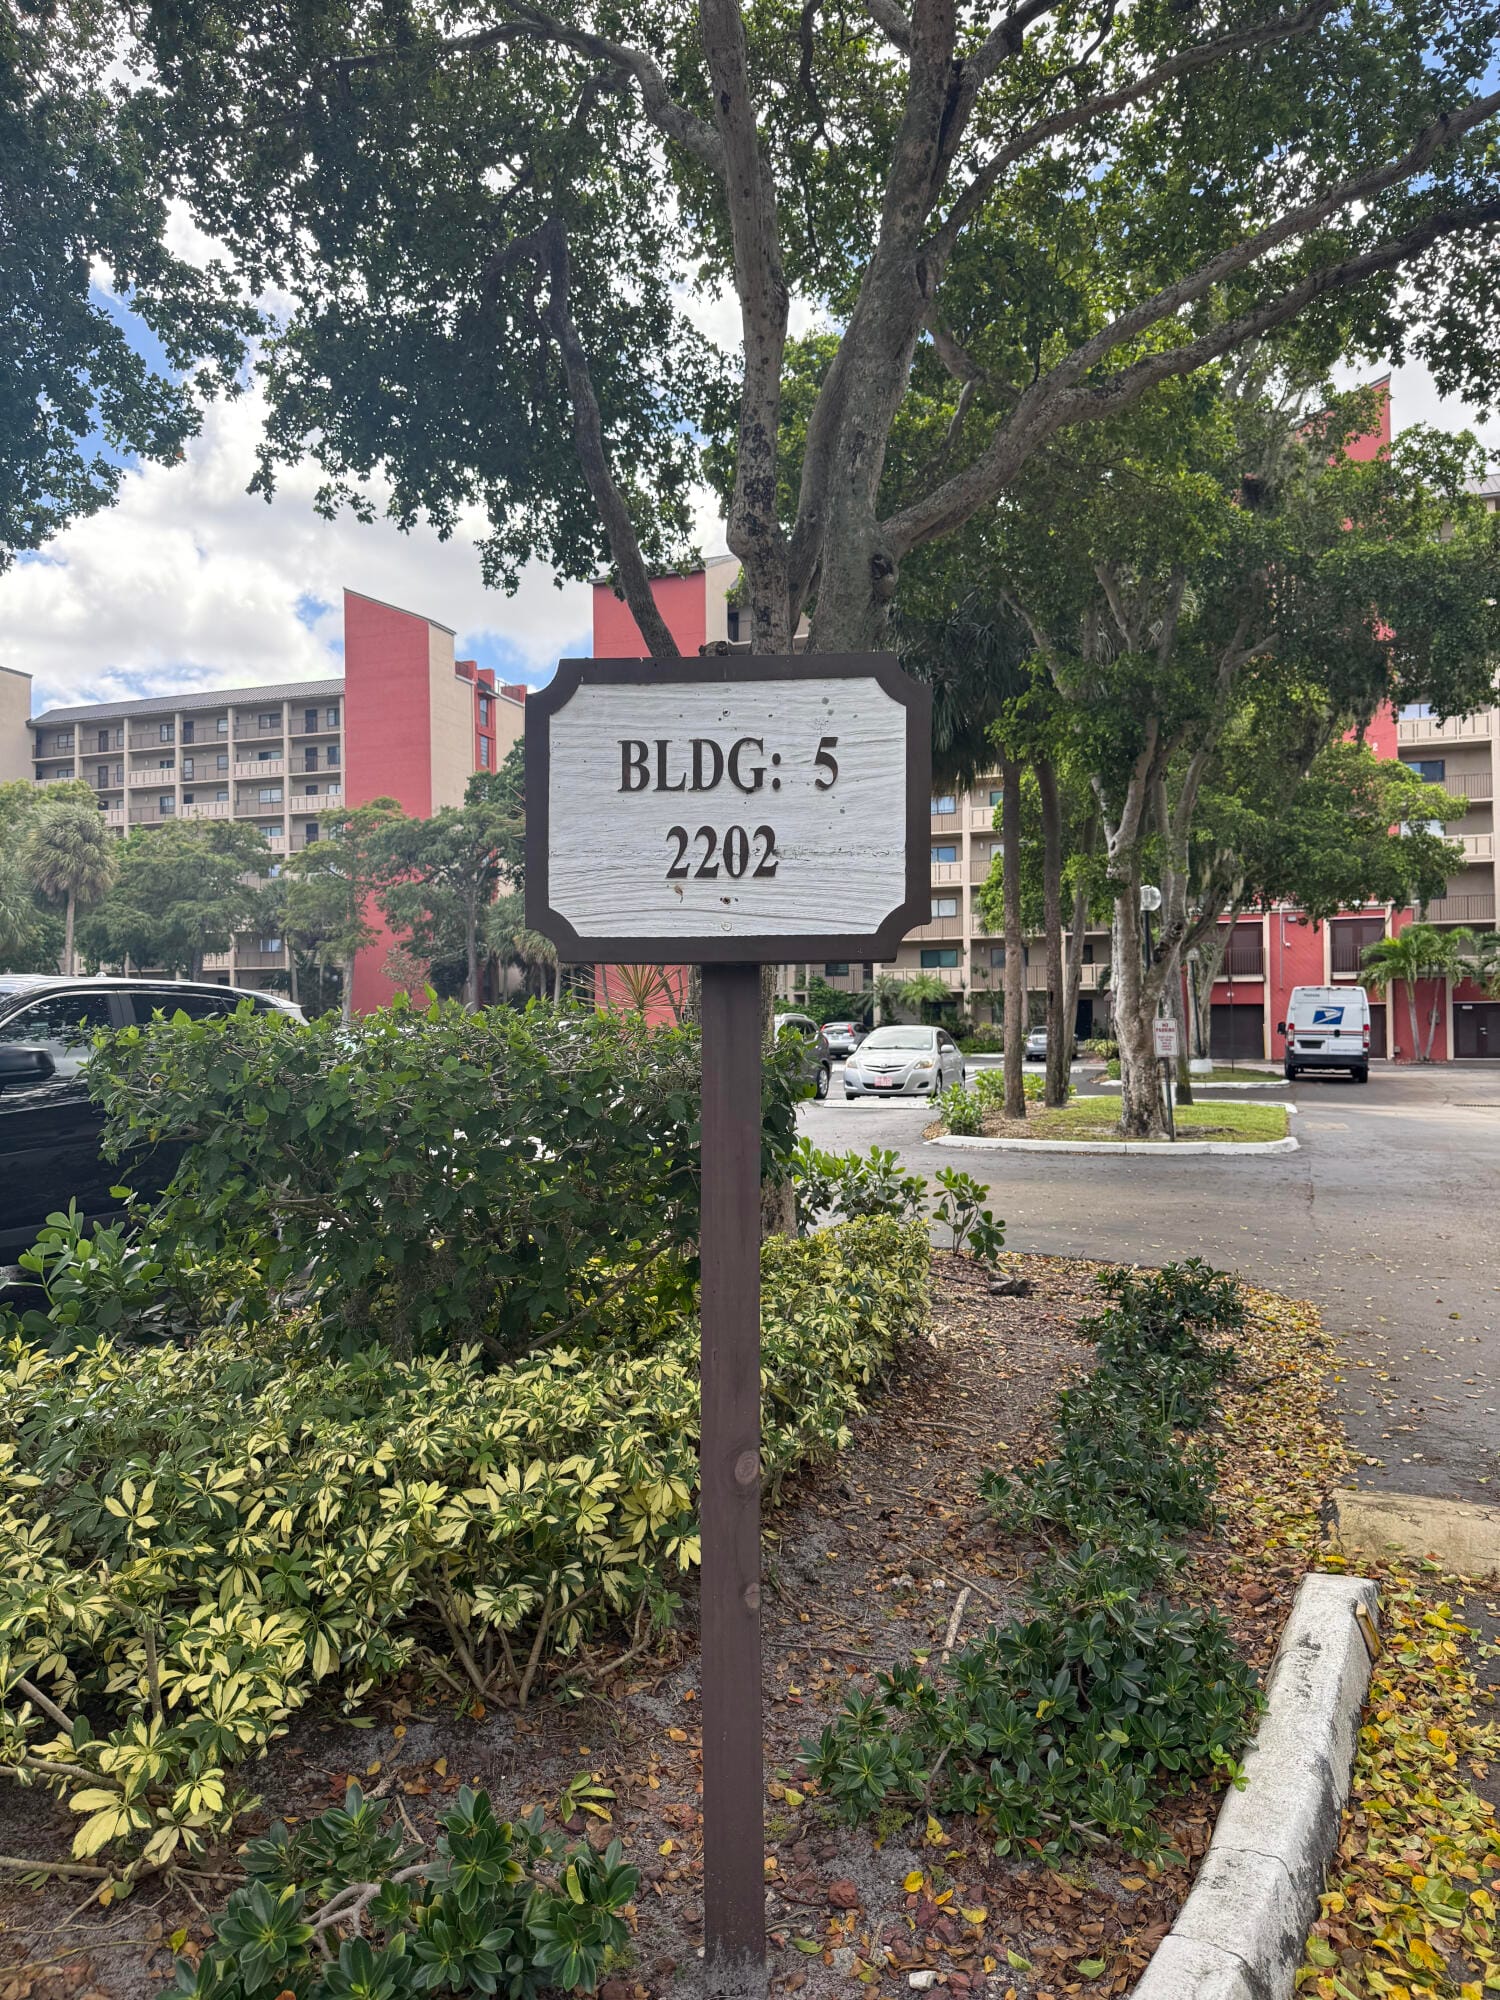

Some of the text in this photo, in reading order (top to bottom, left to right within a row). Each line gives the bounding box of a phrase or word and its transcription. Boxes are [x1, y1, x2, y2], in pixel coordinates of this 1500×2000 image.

[617, 736, 839, 793] BLDG: 5
[665, 825, 779, 879] 2202
